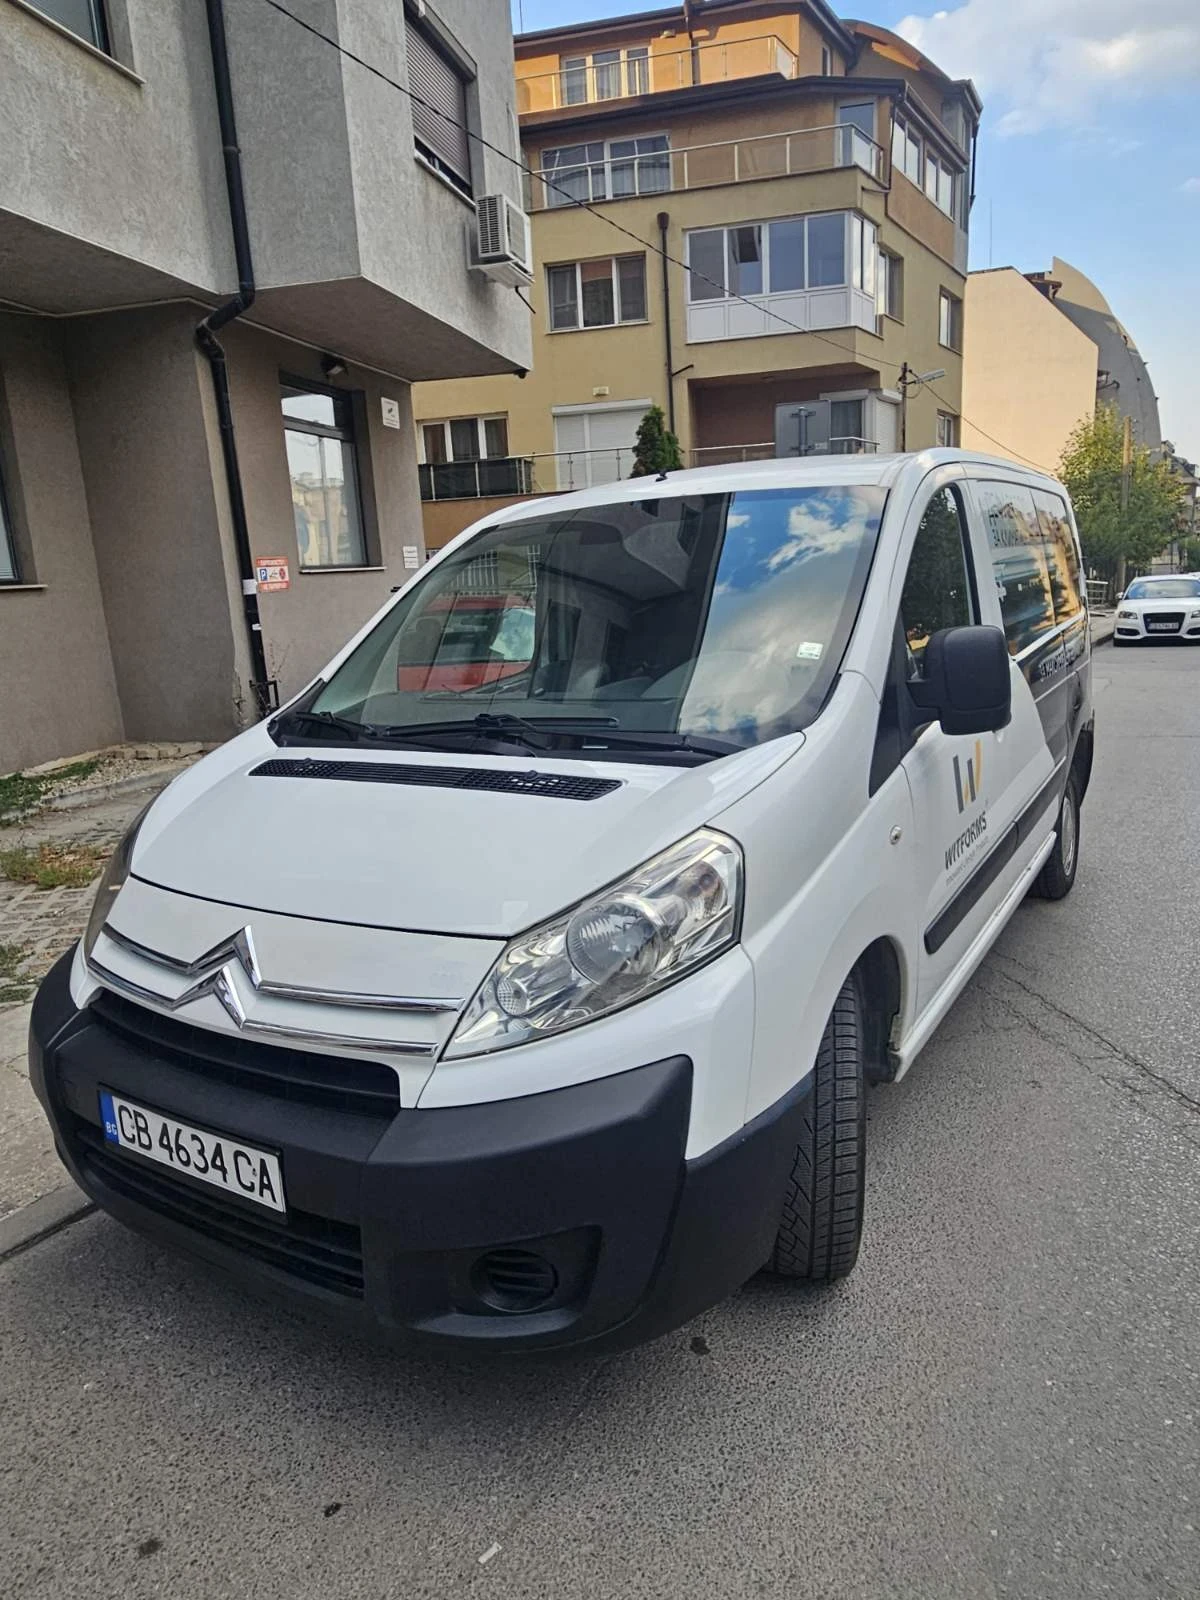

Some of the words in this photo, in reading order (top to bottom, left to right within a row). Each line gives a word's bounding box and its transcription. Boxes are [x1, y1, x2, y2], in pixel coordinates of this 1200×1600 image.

[945, 811, 987, 870] WITFORMS
[106, 1121, 118, 1136] BG
[158, 1122, 228, 1185] 4634
